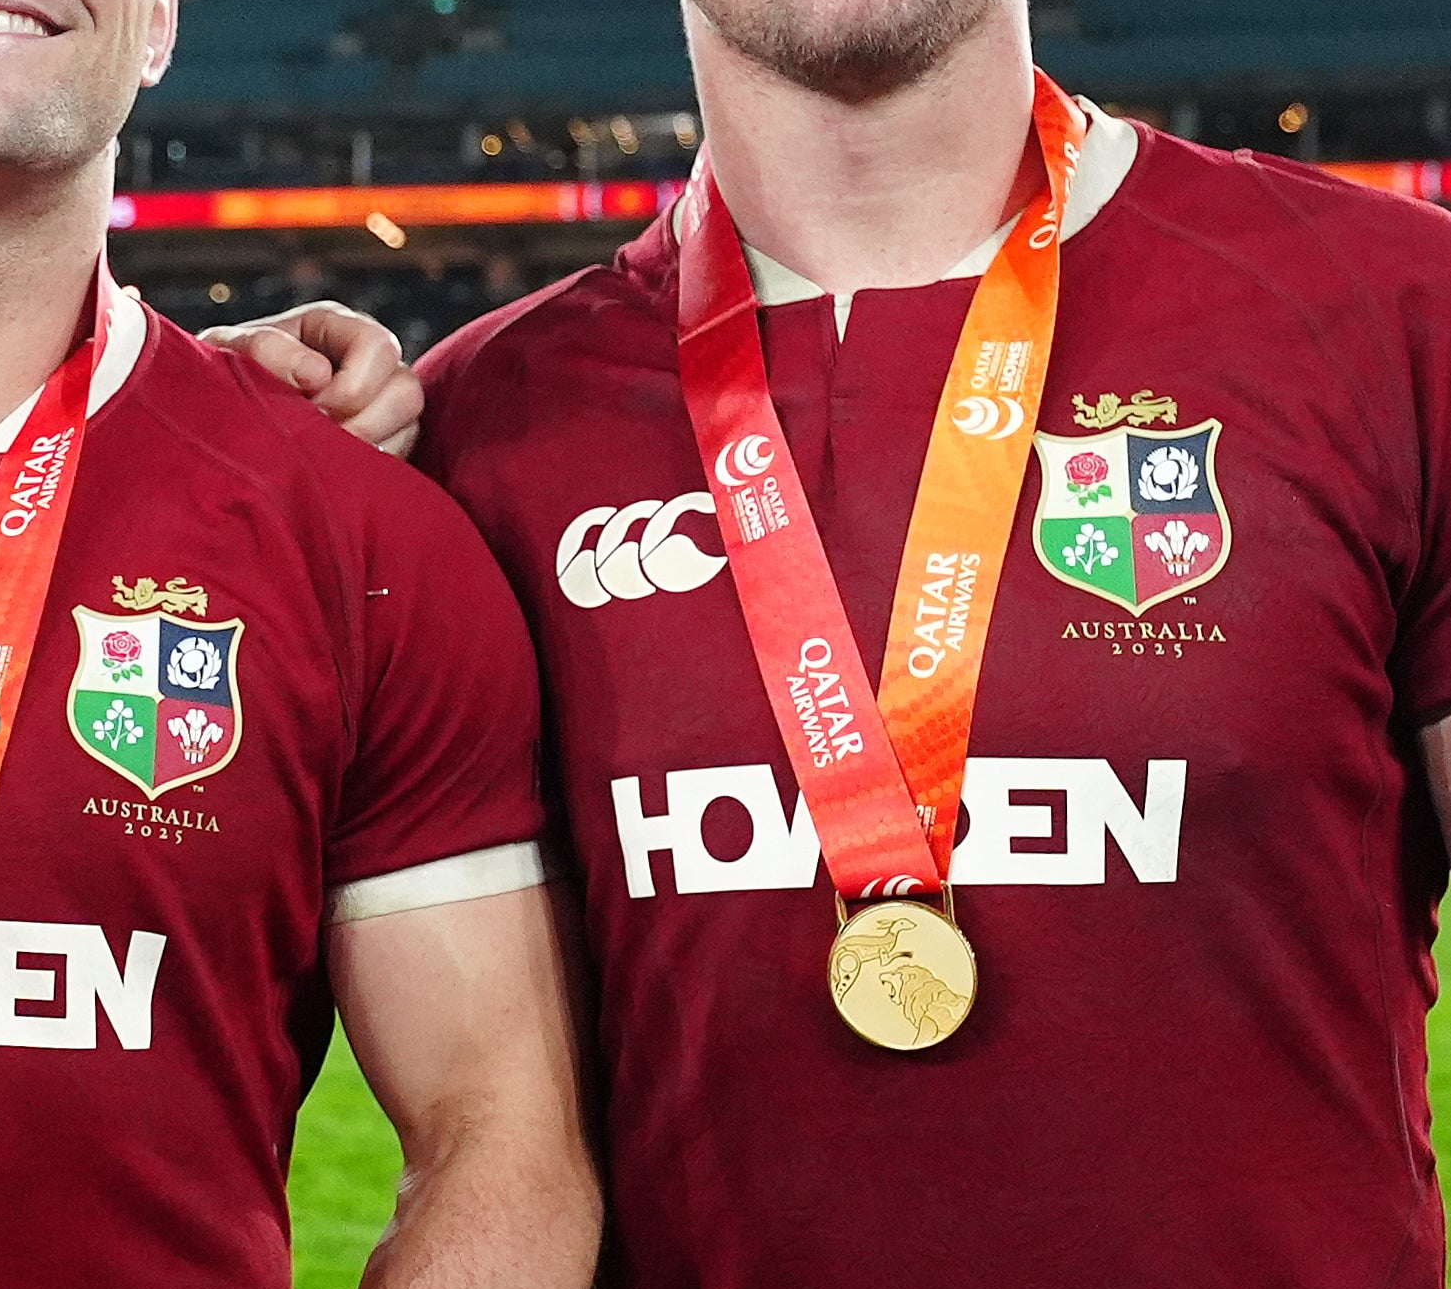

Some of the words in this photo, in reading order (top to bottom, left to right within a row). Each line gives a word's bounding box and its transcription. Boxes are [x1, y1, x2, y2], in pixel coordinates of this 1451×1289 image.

[999, 342, 1023, 392] LIONS
[0, 433, 61, 537] QATAR
[37, 427, 75, 509] AIRWAYS
[741, 487, 766, 540] LIONS
[763, 476, 790, 530] QATAR
[908, 552, 958, 679] QATAR
[945, 553, 981, 652] AIRWAYS
[1061, 622, 1226, 642] AUSTRALIA
[1112, 643, 1183, 658] 2025
[786, 676, 834, 768] AIRWAYS
[798, 637, 864, 762] QATAR
[82, 797, 220, 832] AUSTRALIA
[124, 822, 183, 844] 2025
[611, 758, 1187, 898] HOEN
